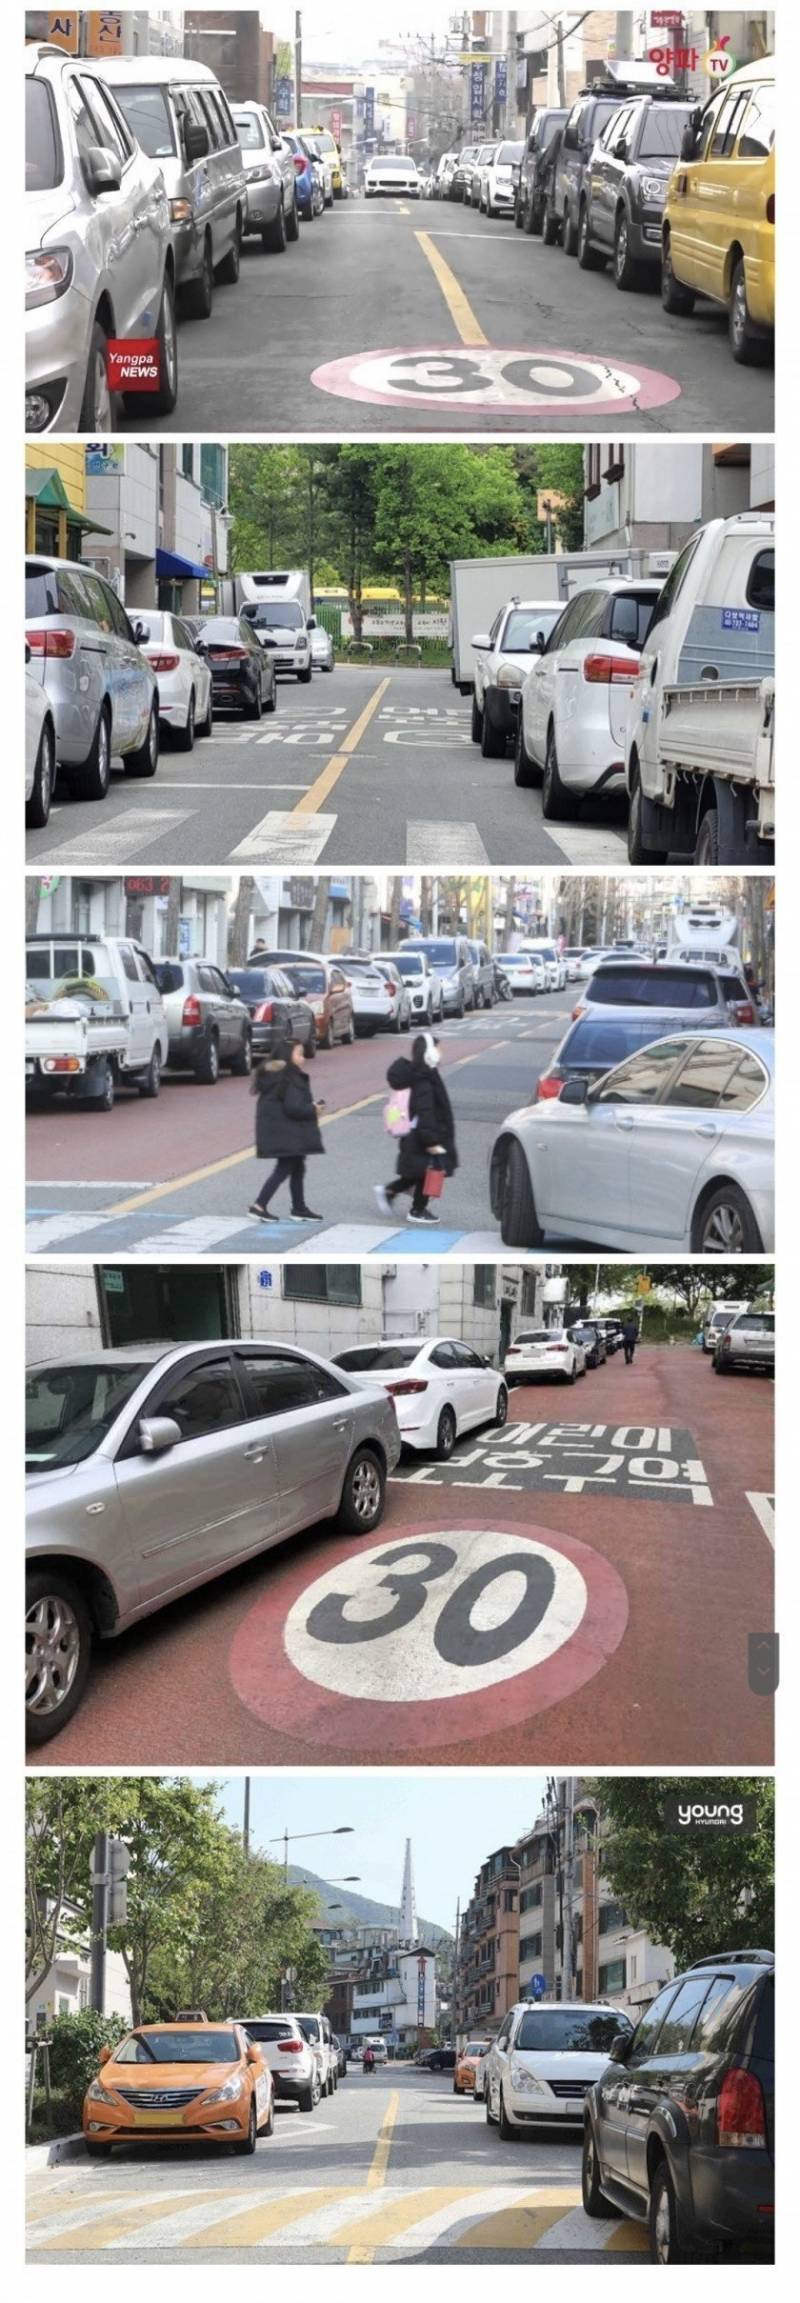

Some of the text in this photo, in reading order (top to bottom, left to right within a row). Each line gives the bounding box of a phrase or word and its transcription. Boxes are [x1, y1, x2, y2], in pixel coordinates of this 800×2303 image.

[386, 355, 603, 397] 30
[475, 1421, 672, 1452] 어린이
[306, 1541, 556, 1667] 30
